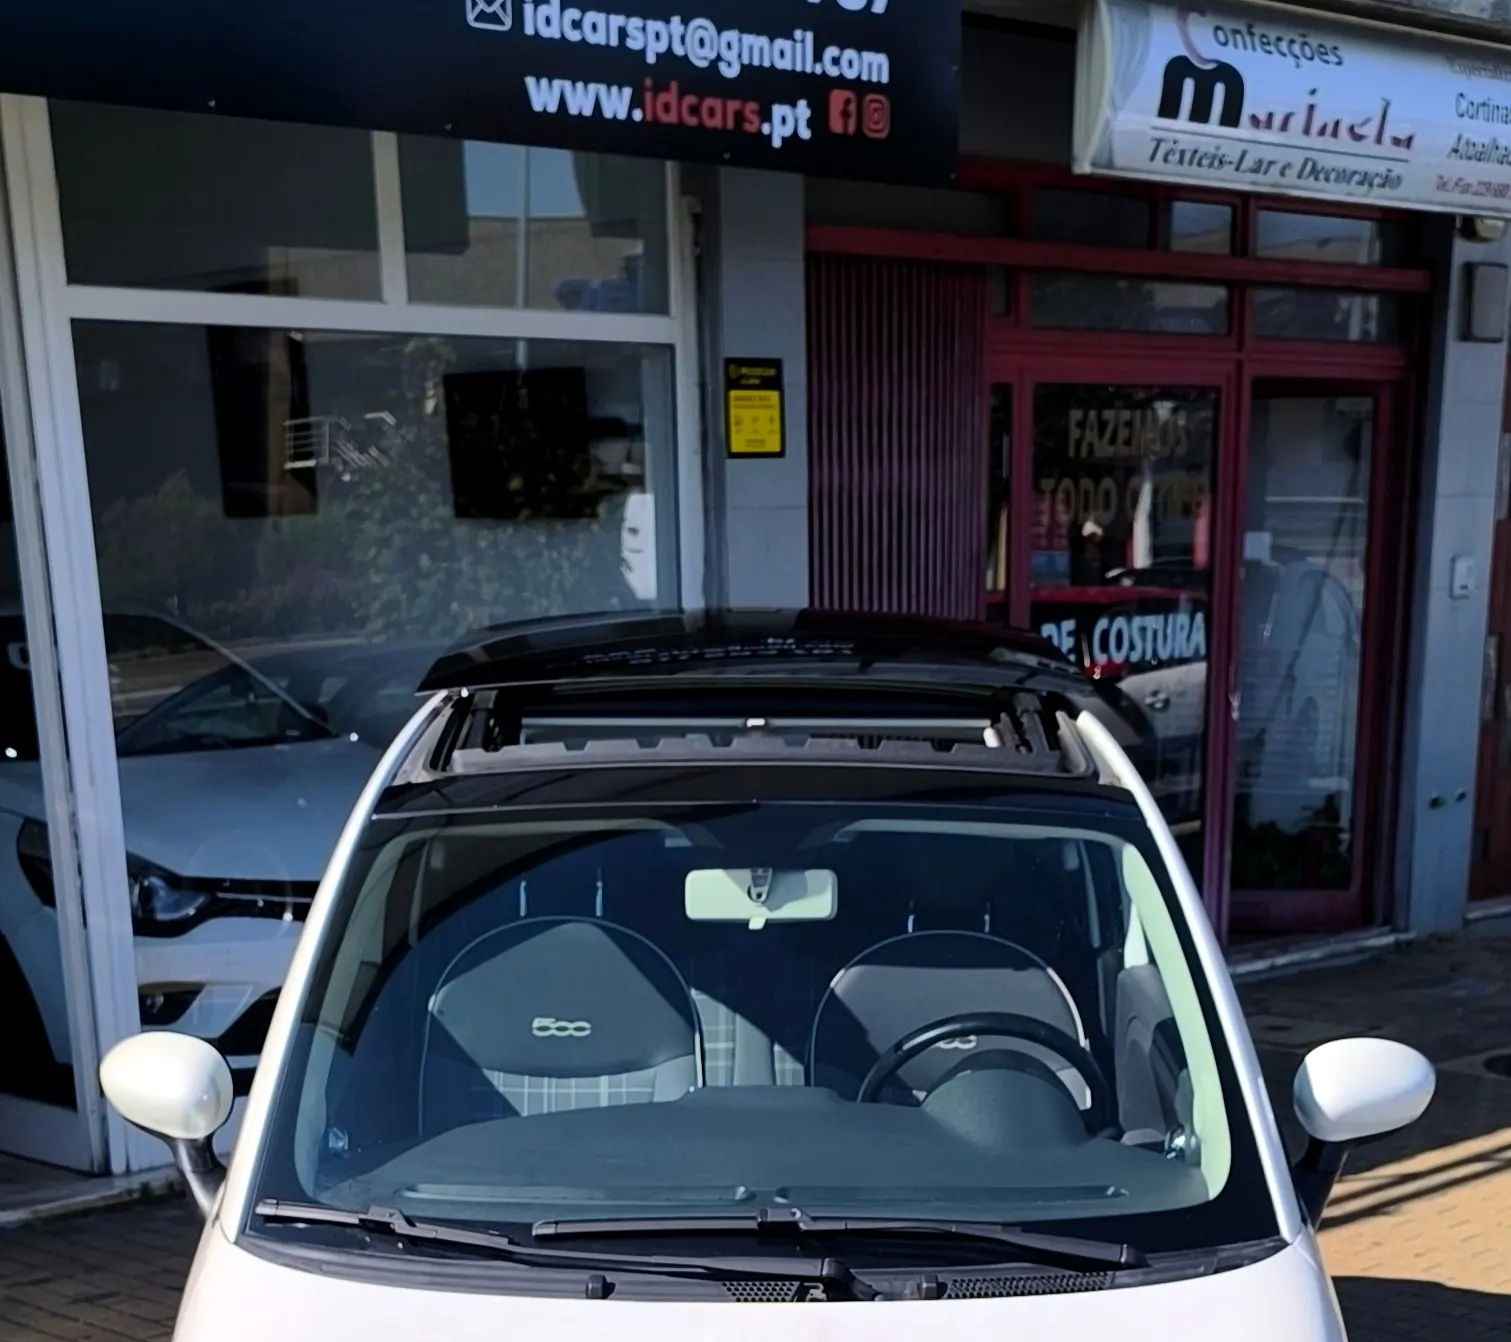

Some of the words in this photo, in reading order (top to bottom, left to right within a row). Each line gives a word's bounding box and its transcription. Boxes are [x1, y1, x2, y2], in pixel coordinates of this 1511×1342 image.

[523, 0, 889, 84] idcarspt@gmail.com
[525, 76, 812, 148] www.idcars.pt
[1279, 160, 1294, 179] e
[1092, 612, 1208, 664] COSTURA
[531, 1016, 592, 1037] 500
